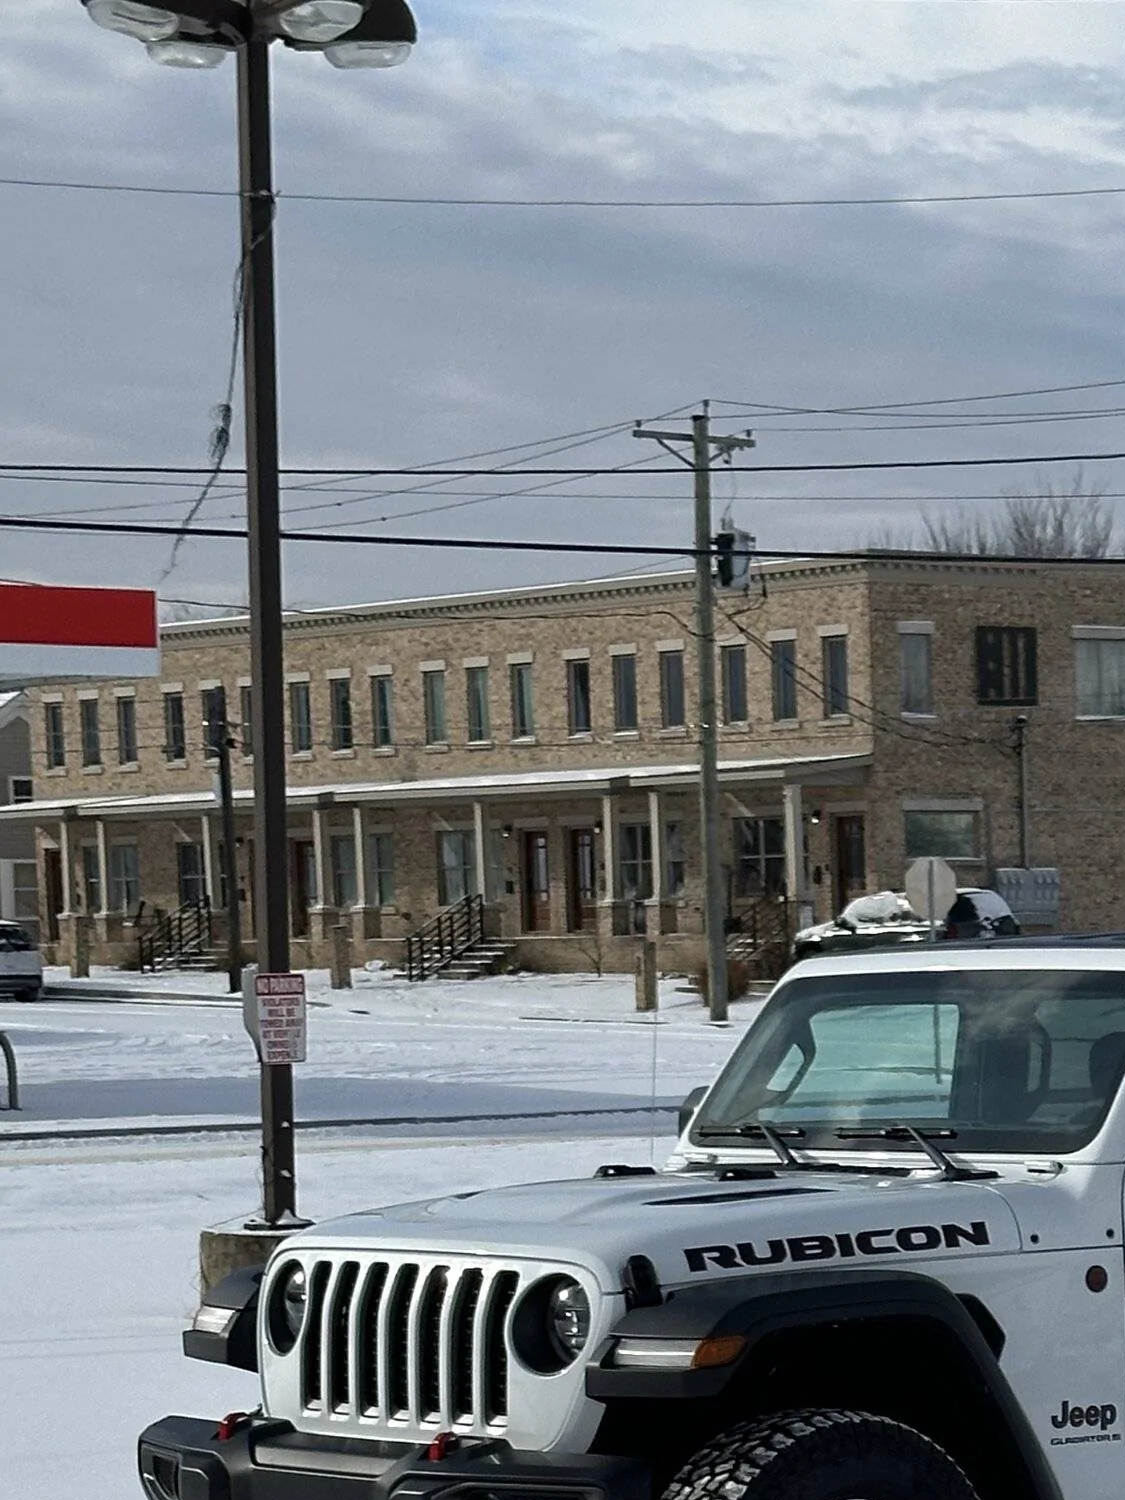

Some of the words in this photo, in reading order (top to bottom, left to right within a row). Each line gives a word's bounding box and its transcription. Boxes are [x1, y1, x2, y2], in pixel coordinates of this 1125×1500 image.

[256, 977, 269, 993] NO
[270, 976, 303, 993] PARKING
[683, 1221, 991, 1272] RUBICON
[1051, 1400, 1117, 1431] Jeep
